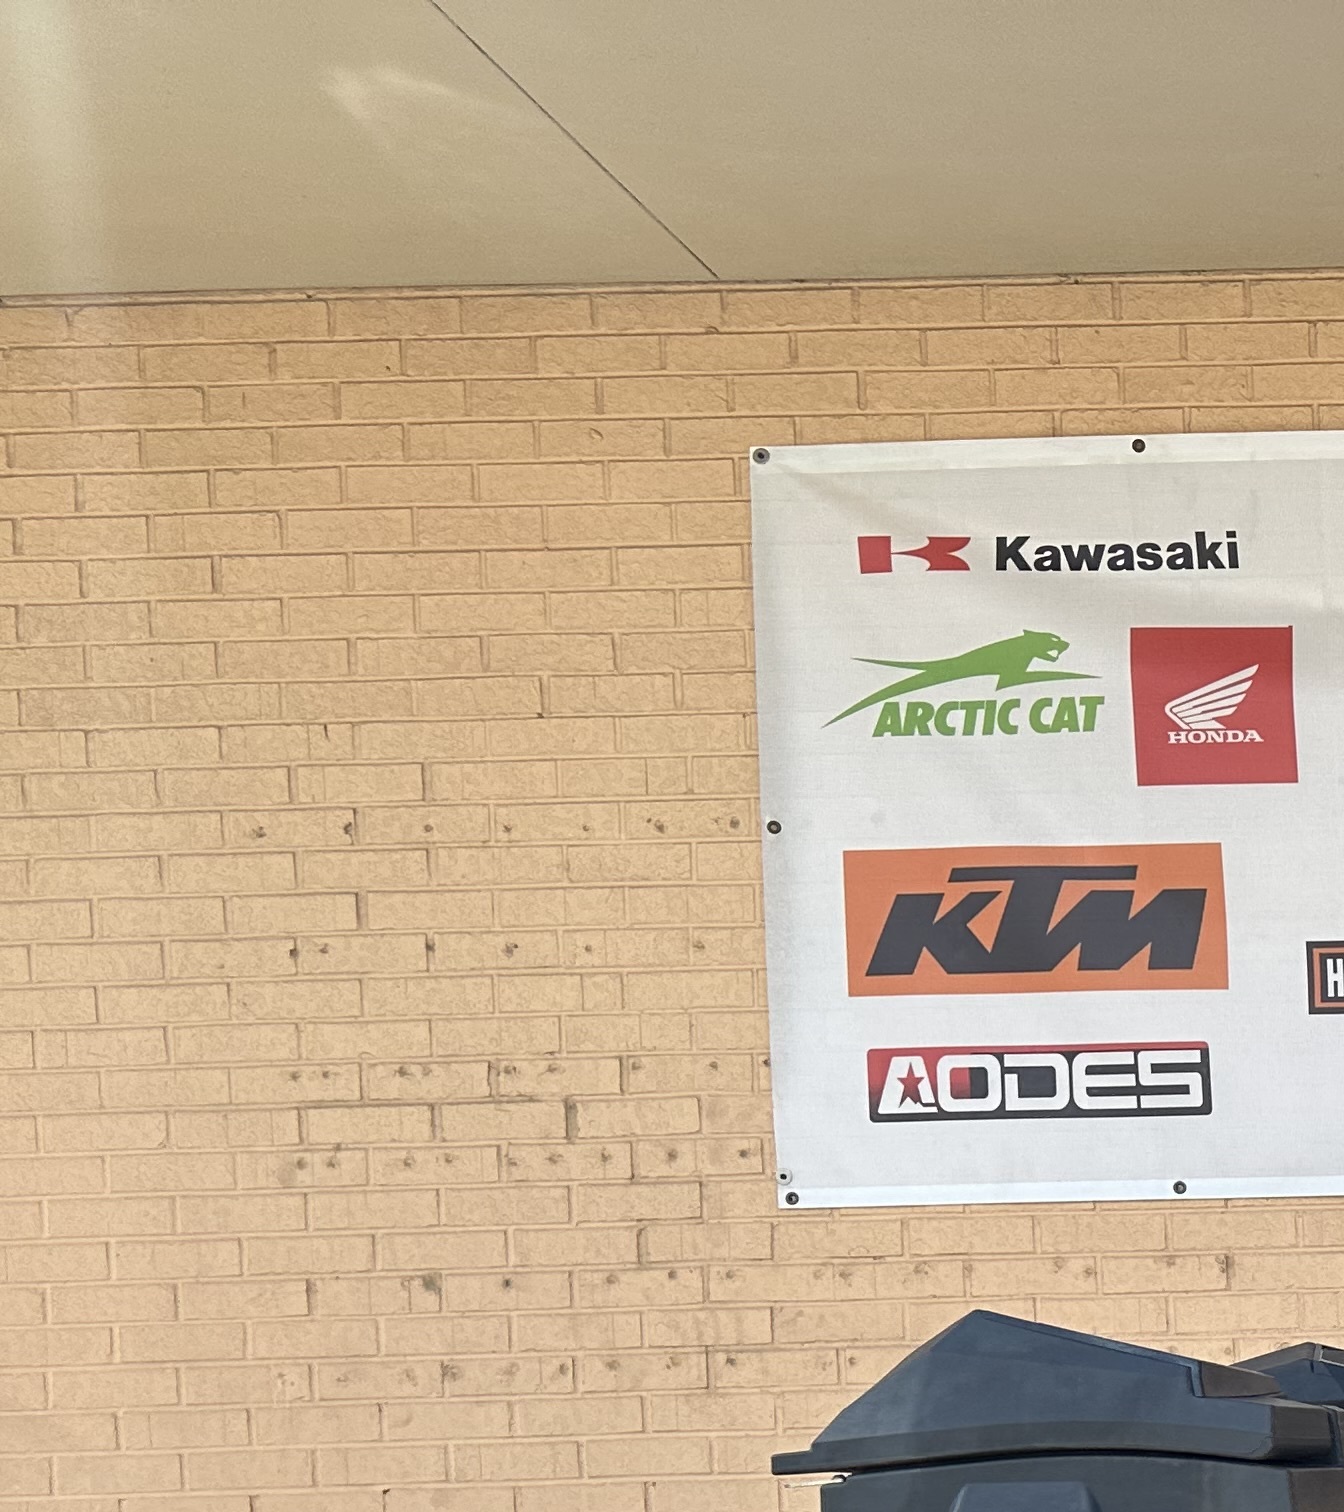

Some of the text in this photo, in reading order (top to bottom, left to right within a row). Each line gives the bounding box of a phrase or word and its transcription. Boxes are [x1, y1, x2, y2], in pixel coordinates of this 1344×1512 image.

[995, 530, 1241, 573] Kawasaki
[871, 694, 1105, 739] ARCTIC CAT
[1167, 729, 1264, 744] HONDA
[864, 864, 1208, 977] KTM
[877, 1047, 1205, 1115] AODES
